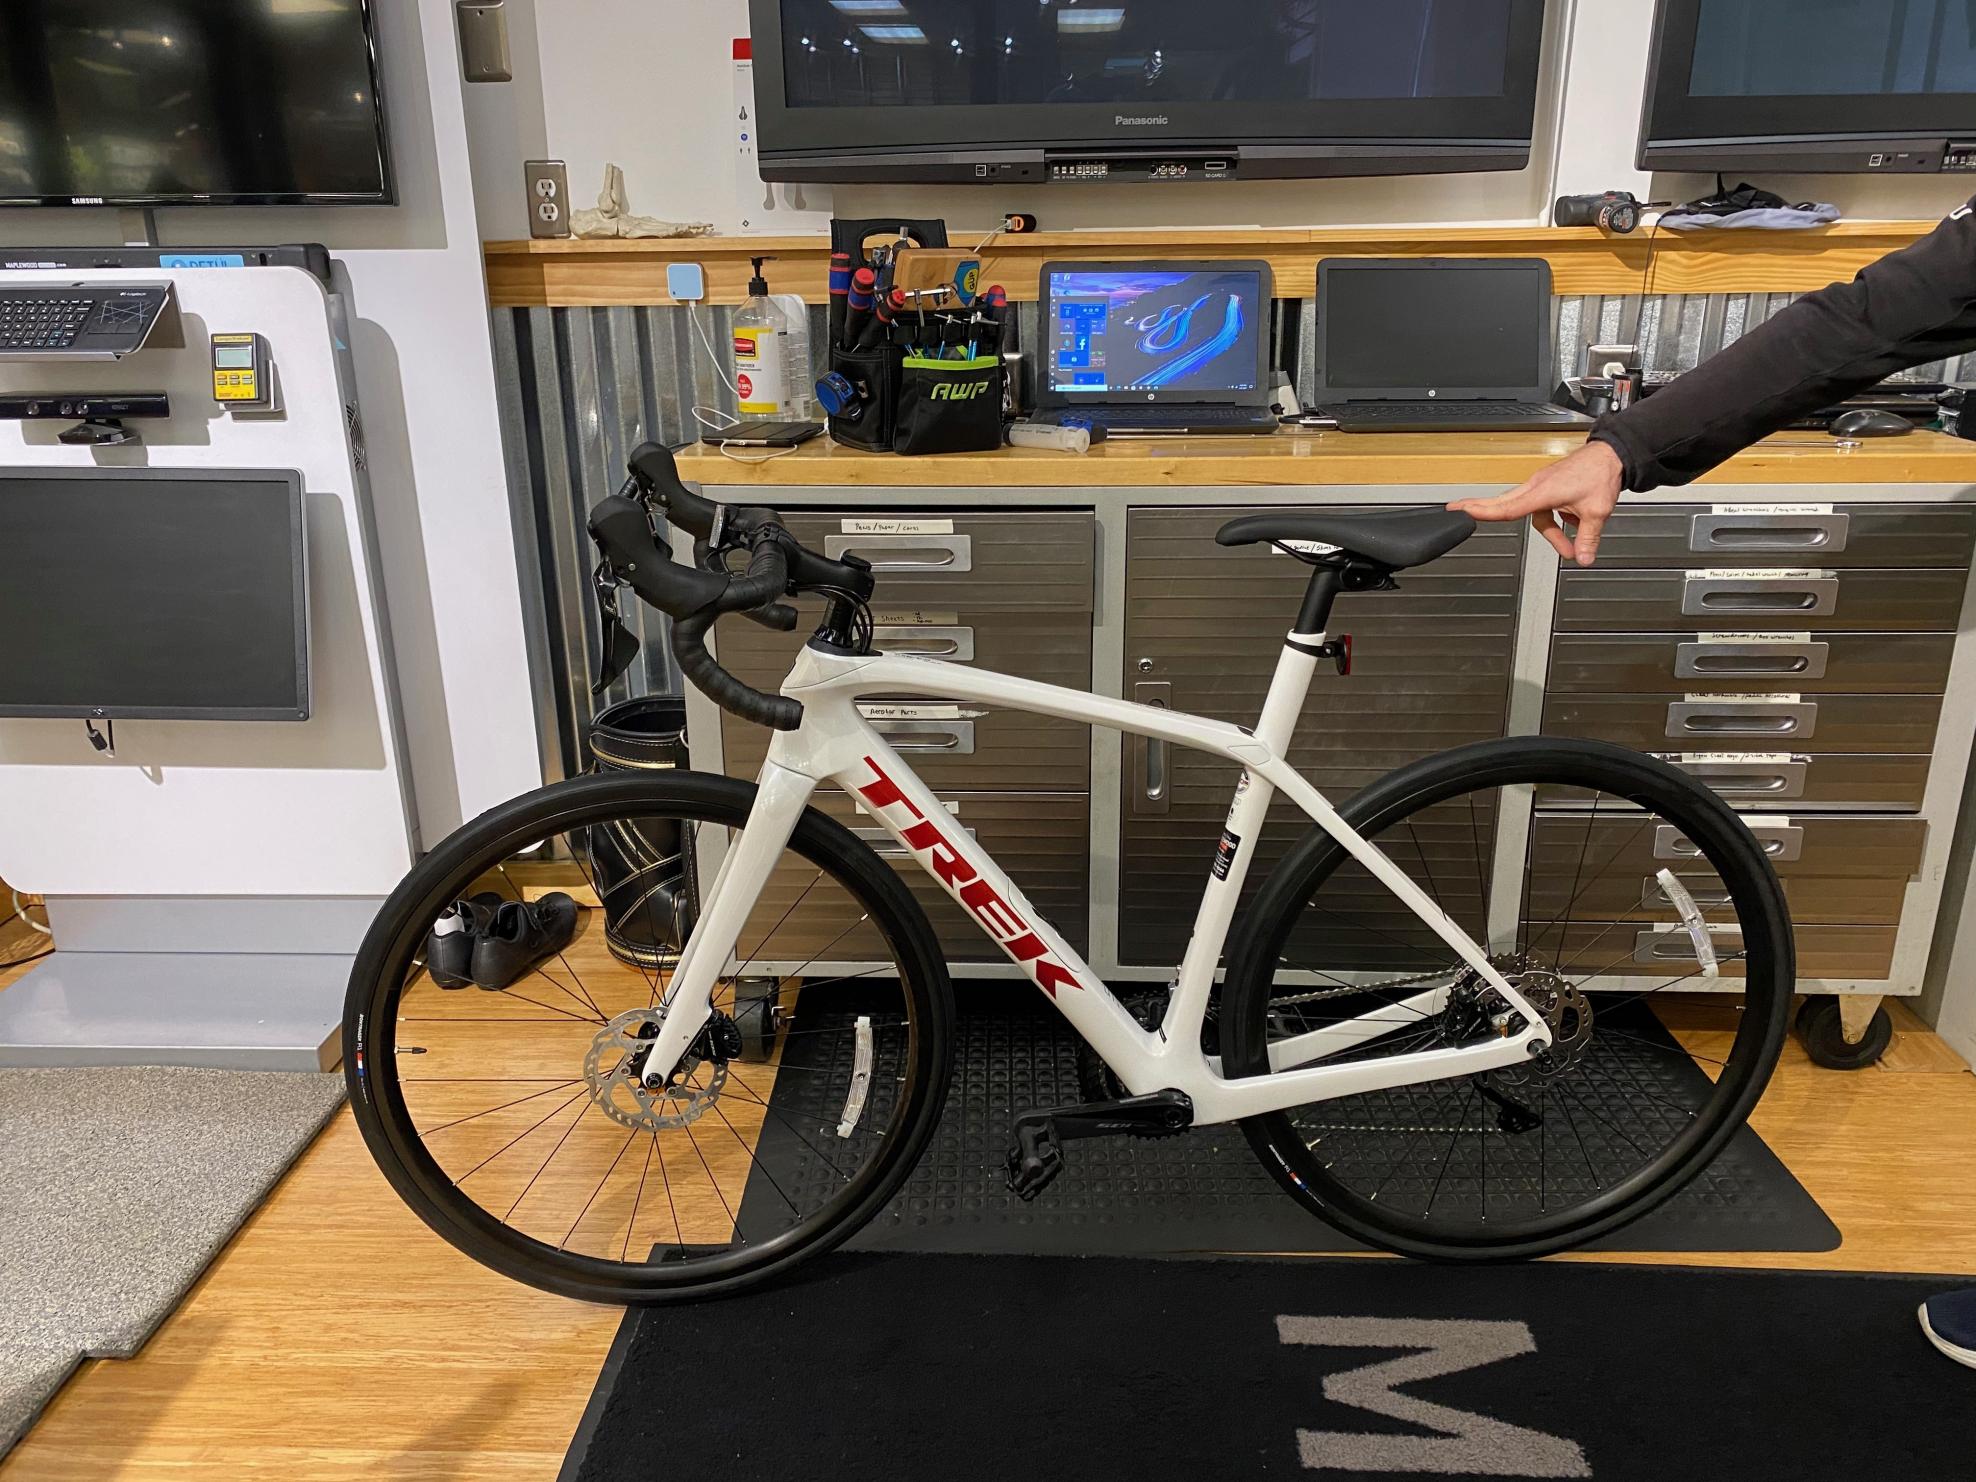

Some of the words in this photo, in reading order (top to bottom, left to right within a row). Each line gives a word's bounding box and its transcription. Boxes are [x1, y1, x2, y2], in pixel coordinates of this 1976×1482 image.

[1115, 115, 1168, 125] Panasonic
[71, 197, 103, 205] SAMSUNG
[930, 381, 989, 400] AWP
[858, 756, 1085, 1000] TREK
